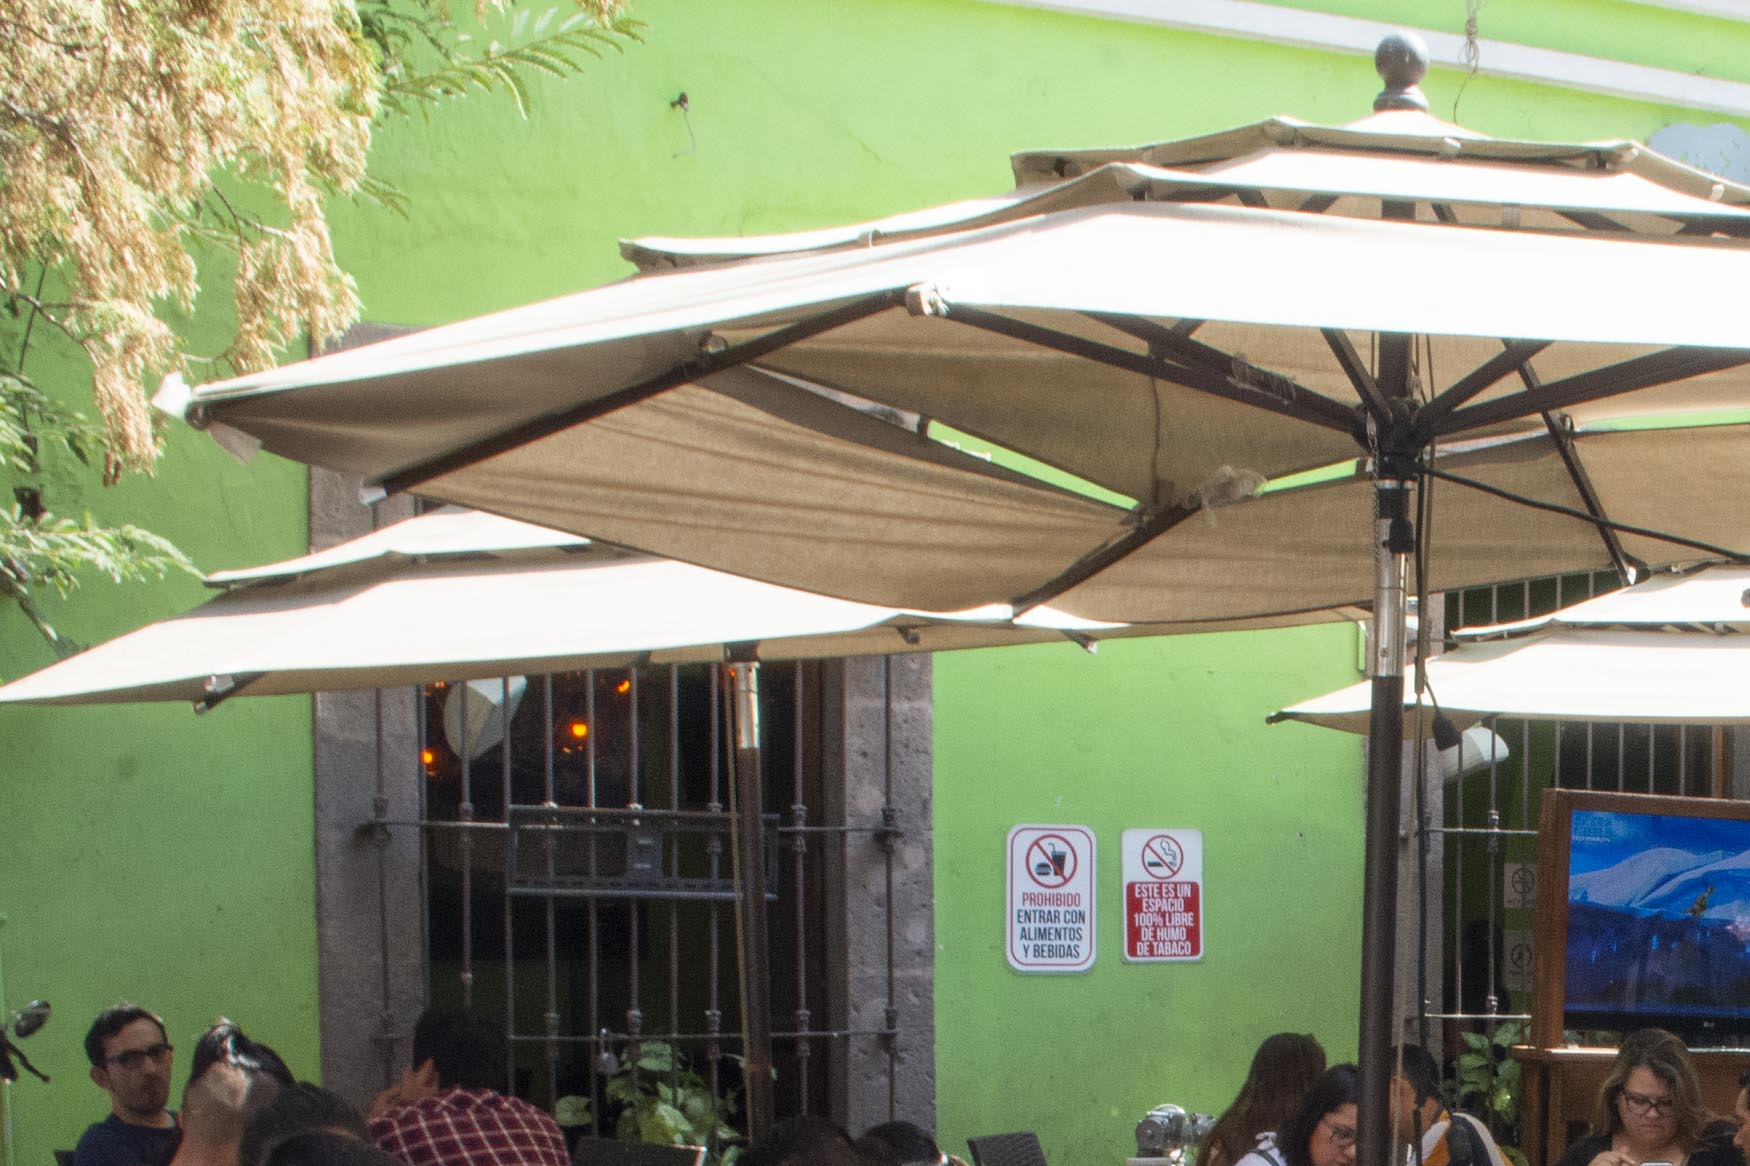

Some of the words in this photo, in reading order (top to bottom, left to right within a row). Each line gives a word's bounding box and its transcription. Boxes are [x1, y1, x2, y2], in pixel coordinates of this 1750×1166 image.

[1135, 883, 1158, 898] ESTE
[1162, 883, 1174, 898] ES
[1177, 883, 1191, 898] UN
[1022, 892, 1081, 907] PROHIBIDO
[1142, 897, 1184, 912] ESPACIO
[1017, 909, 1060, 924] ENTRAR
[1063, 909, 1086, 924] CON
[1134, 912, 1163, 927] 100%
[1165, 912, 1194, 927] LIBRE
[1020, 926, 1083, 941] ALIMENTOS
[1141, 926, 1154, 941] DE
[1157, 926, 1187, 941] HUMO
[1023, 944, 1030, 959] Y
[1033, 944, 1080, 959] BEBIDAS
[1136, 941, 1150, 956] DE
[1152, 941, 1191, 956] TABACO
